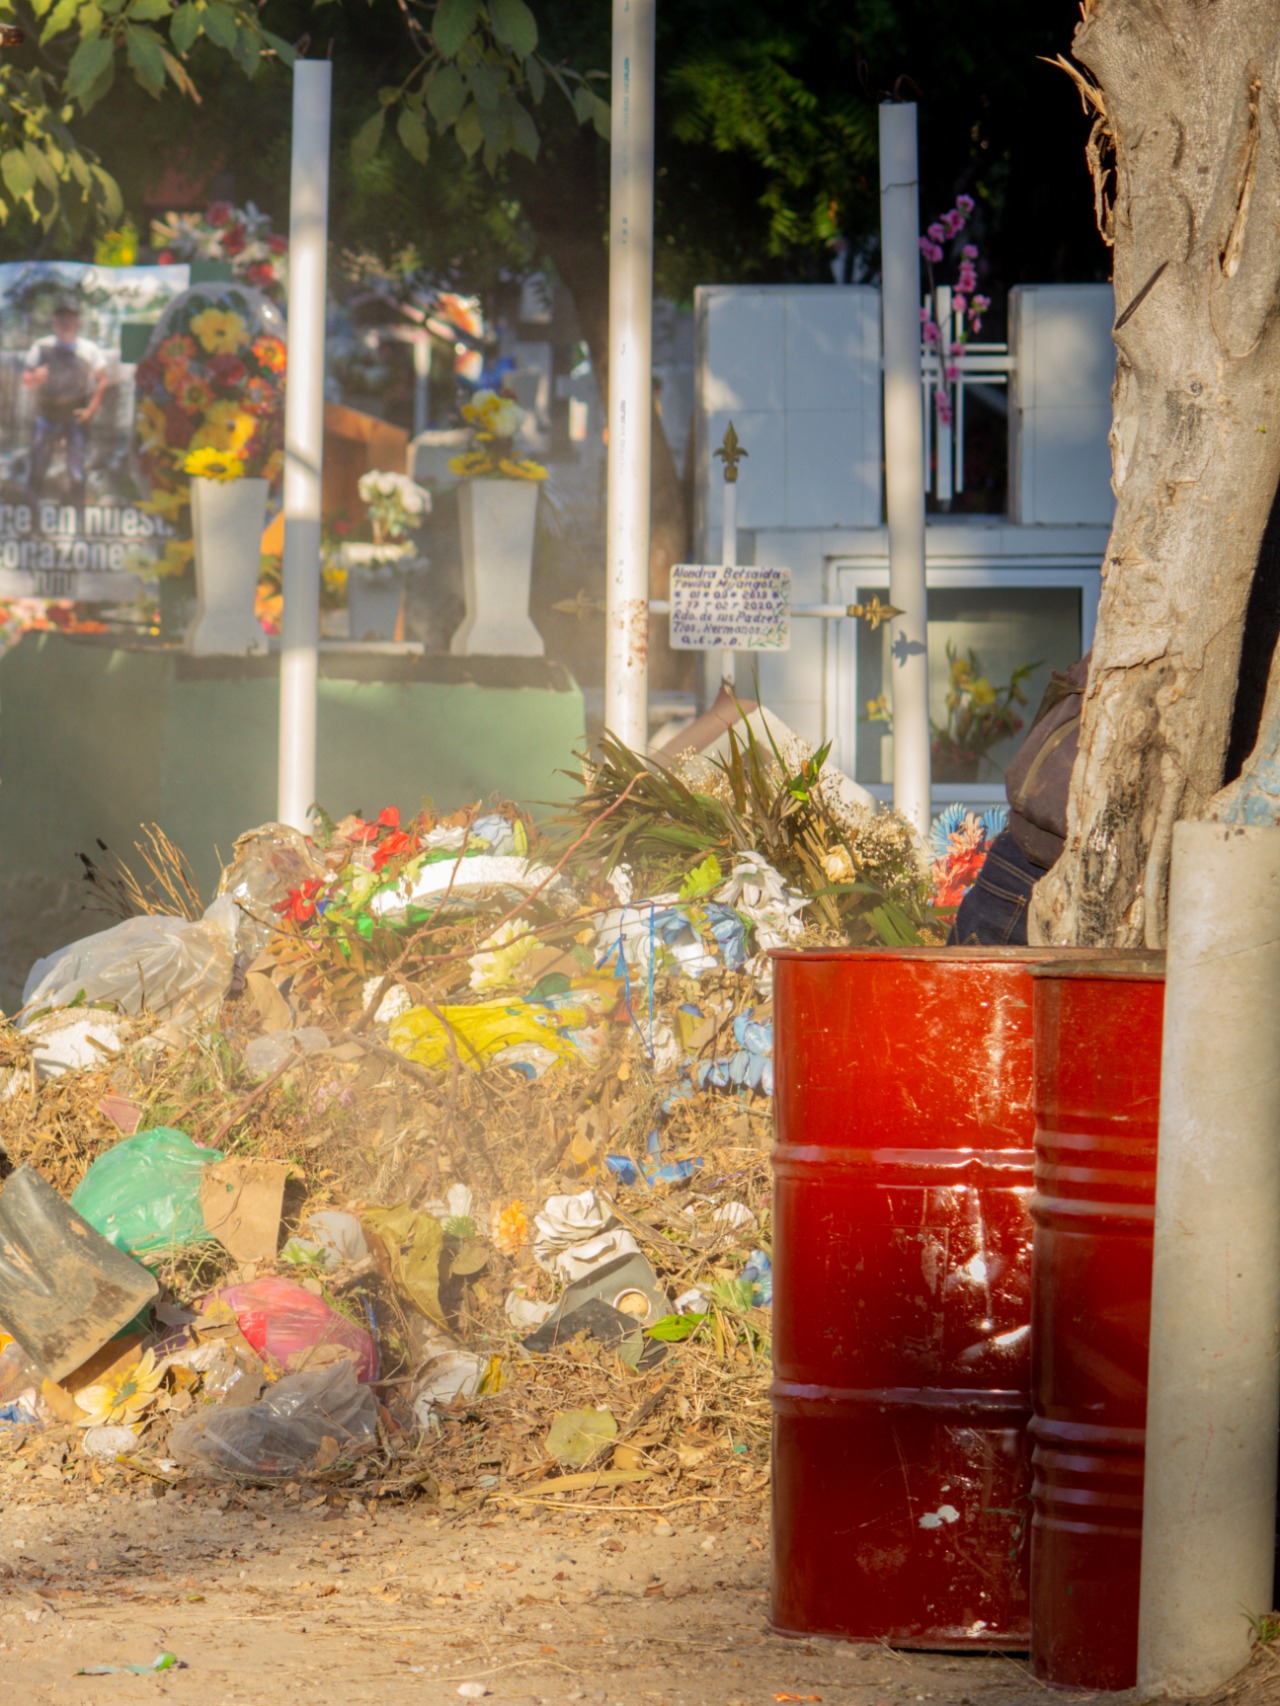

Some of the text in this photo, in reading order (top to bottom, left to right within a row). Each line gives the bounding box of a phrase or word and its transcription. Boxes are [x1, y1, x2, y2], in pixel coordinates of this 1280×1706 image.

[40, 504, 77, 535] en
[700, 609, 712, 621] de
[716, 613, 733, 621] sus
